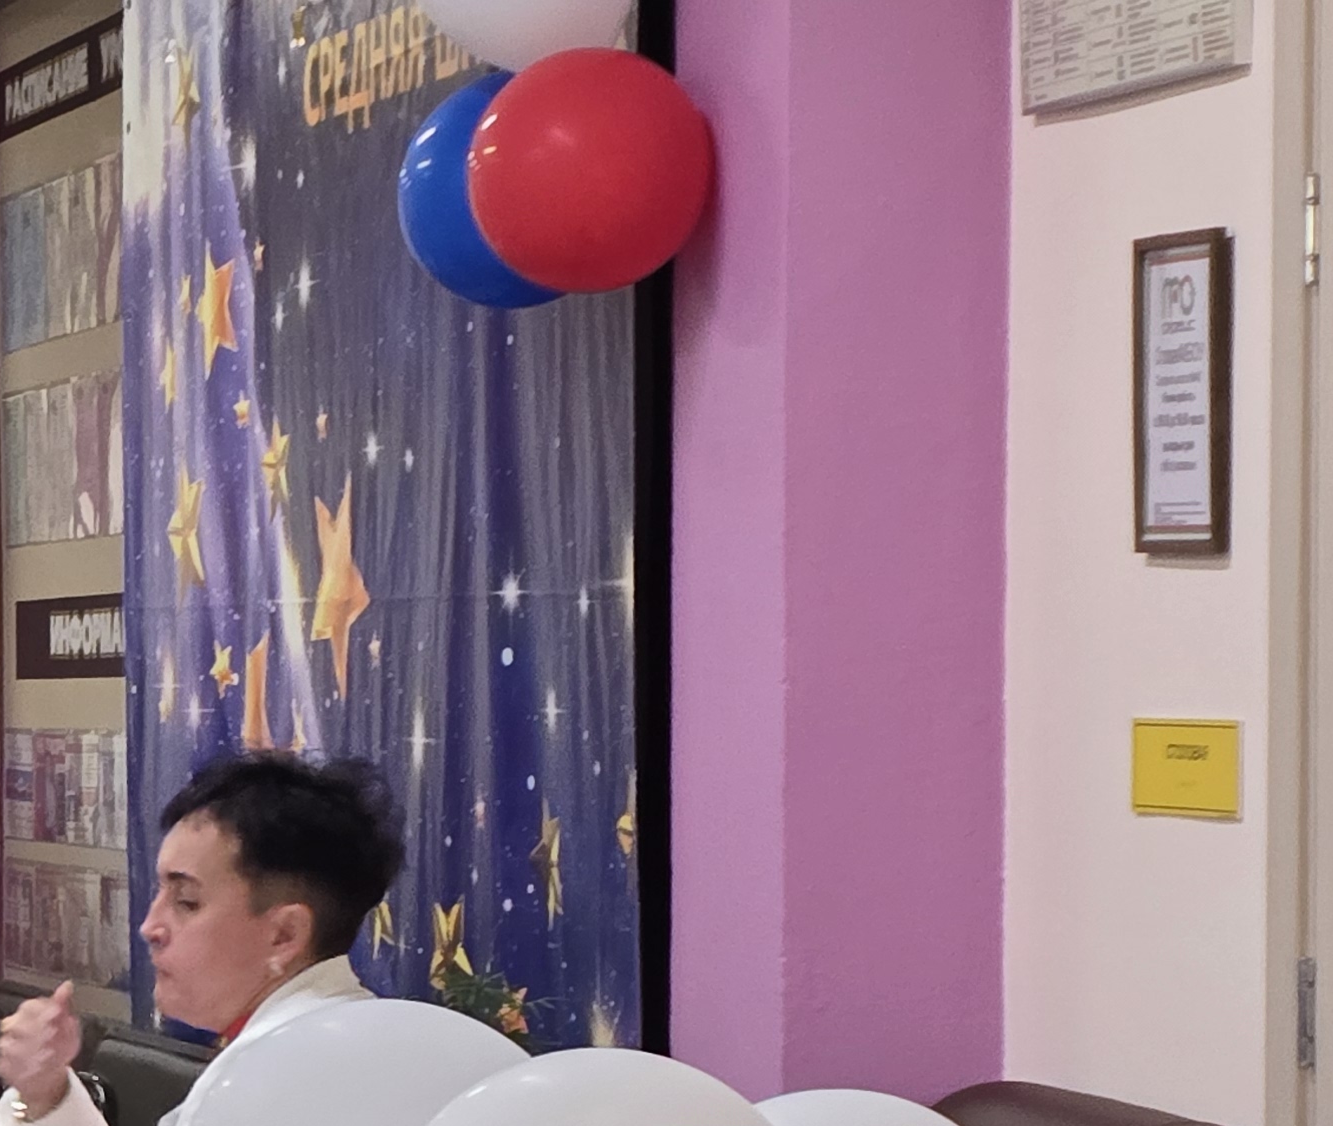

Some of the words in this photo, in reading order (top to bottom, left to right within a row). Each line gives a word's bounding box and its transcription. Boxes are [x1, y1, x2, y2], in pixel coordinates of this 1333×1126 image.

[4, 43, 89, 124] РАСПИСАНИЕ
[303, 4, 426, 134] СРЕДНЯЯ
[49, 606, 126, 658] ИНФОРМА
